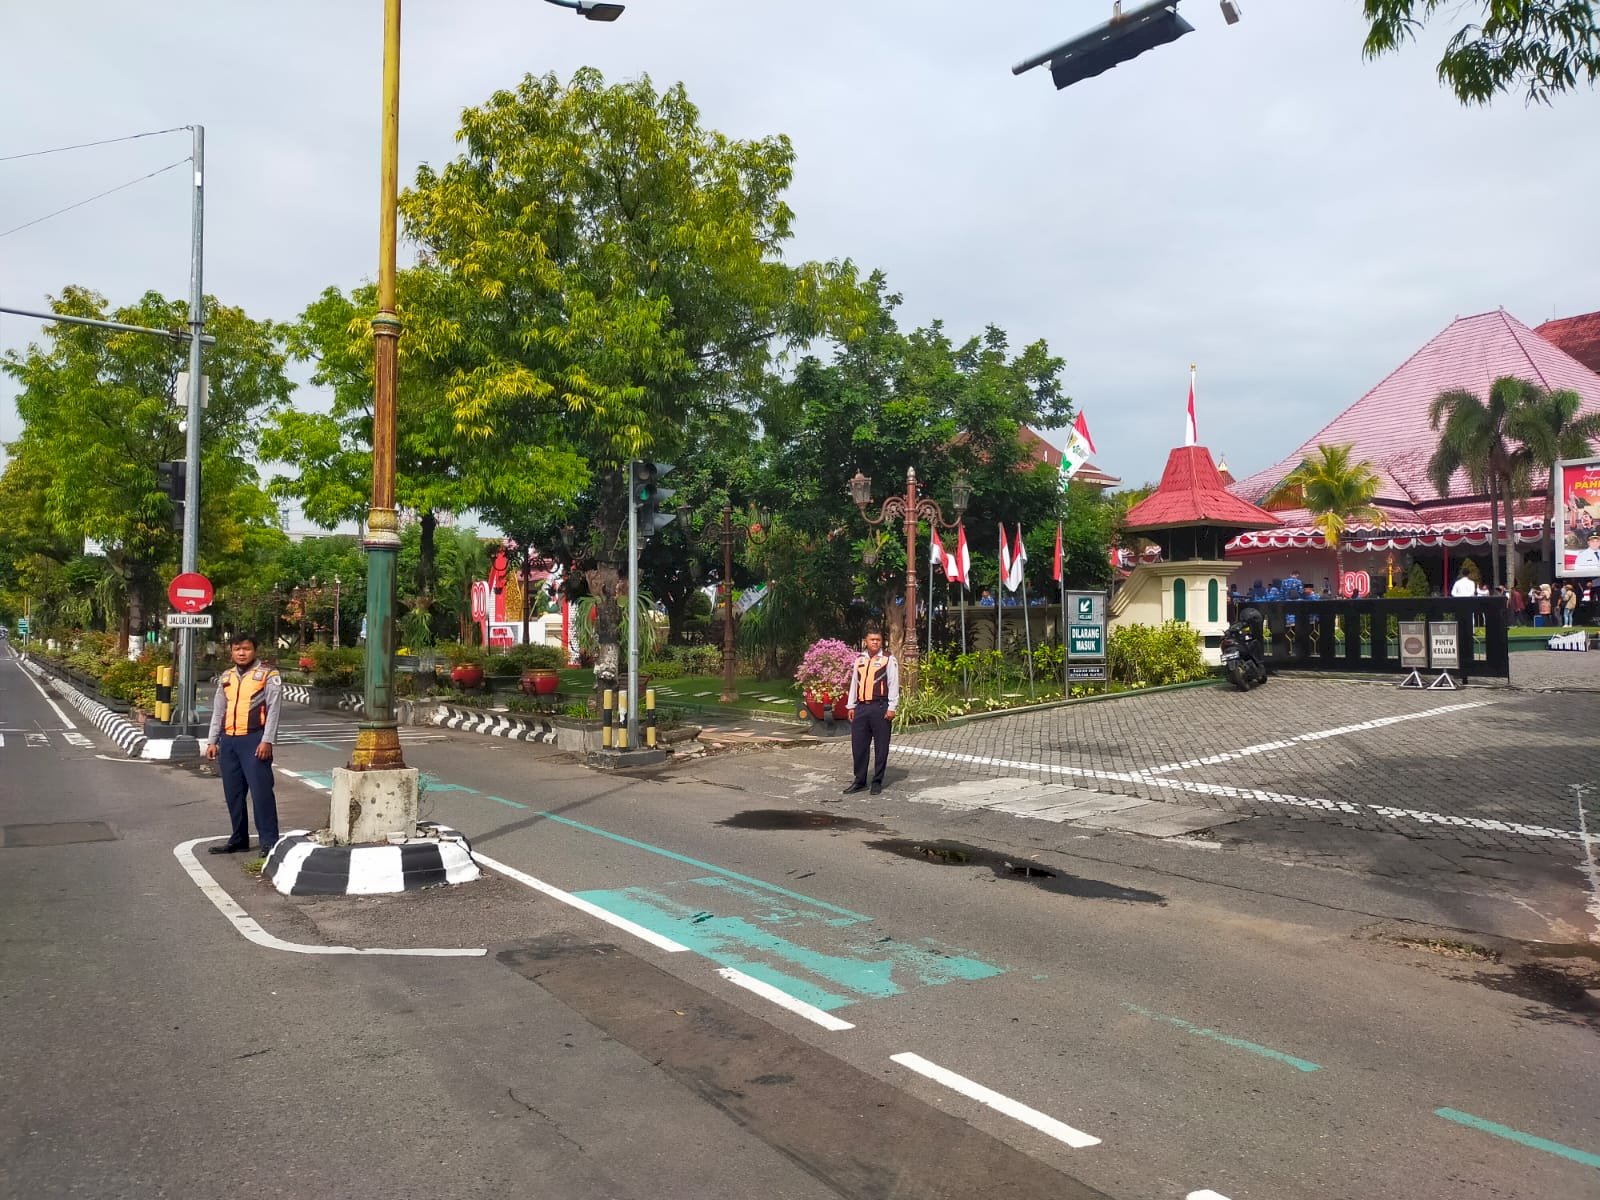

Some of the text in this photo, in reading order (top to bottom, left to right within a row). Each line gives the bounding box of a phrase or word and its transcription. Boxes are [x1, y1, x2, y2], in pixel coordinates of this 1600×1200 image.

[1574, 479, 1600, 490] PAH
[1342, 570, 1370, 598] 80
[169, 616, 209, 625] JALUR LAMBAT
[1072, 628, 1099, 639] DILARANG
[1076, 640, 1096, 651] MASUK
[1433, 647, 1456, 655] KELUAR
